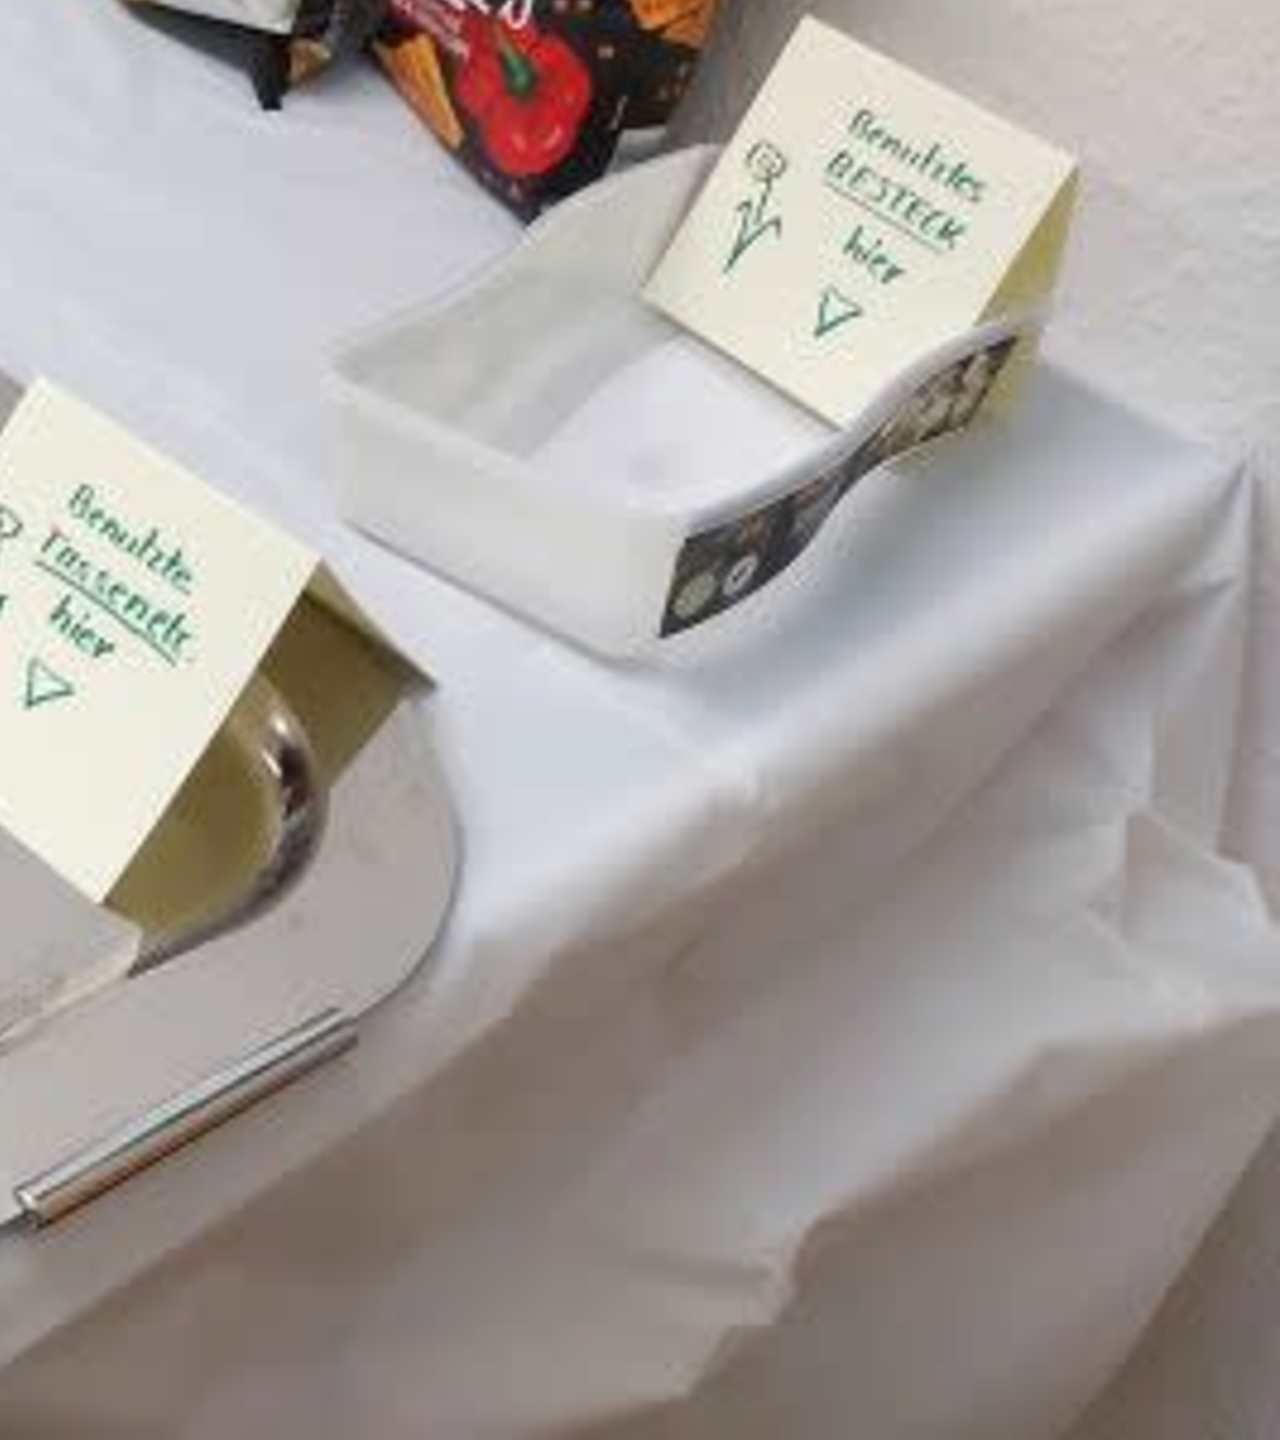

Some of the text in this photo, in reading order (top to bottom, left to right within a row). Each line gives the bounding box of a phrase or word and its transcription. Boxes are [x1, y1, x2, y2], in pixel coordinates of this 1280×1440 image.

[825, 150, 966, 252] BESTECK
[842, 224, 907, 285] hier
[69, 483, 193, 596] Benutzte
[50, 594, 116, 659] hier
